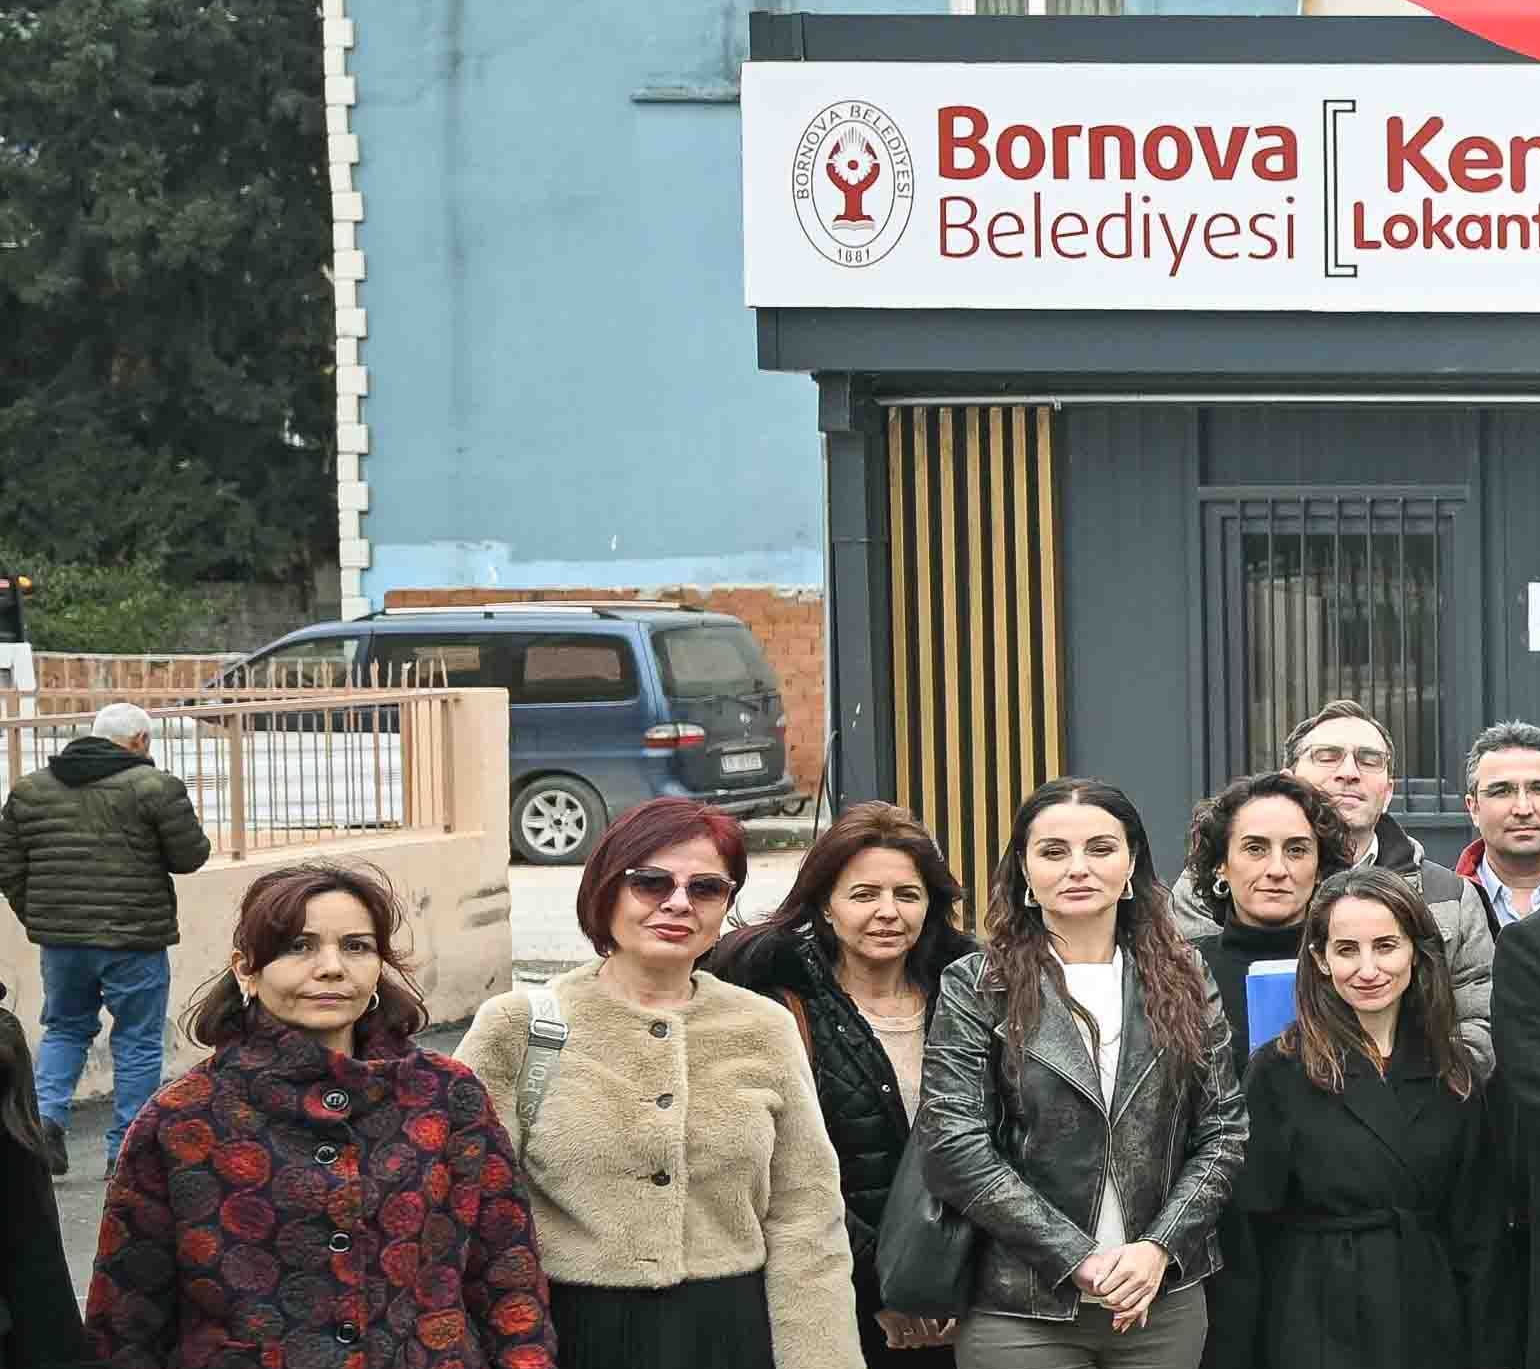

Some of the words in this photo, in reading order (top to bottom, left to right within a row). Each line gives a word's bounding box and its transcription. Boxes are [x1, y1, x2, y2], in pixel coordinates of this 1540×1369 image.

[796, 110, 843, 200] BORNOVA
[937, 105, 1298, 181] Bornova
[939, 191, 1296, 278] Belediyesi
